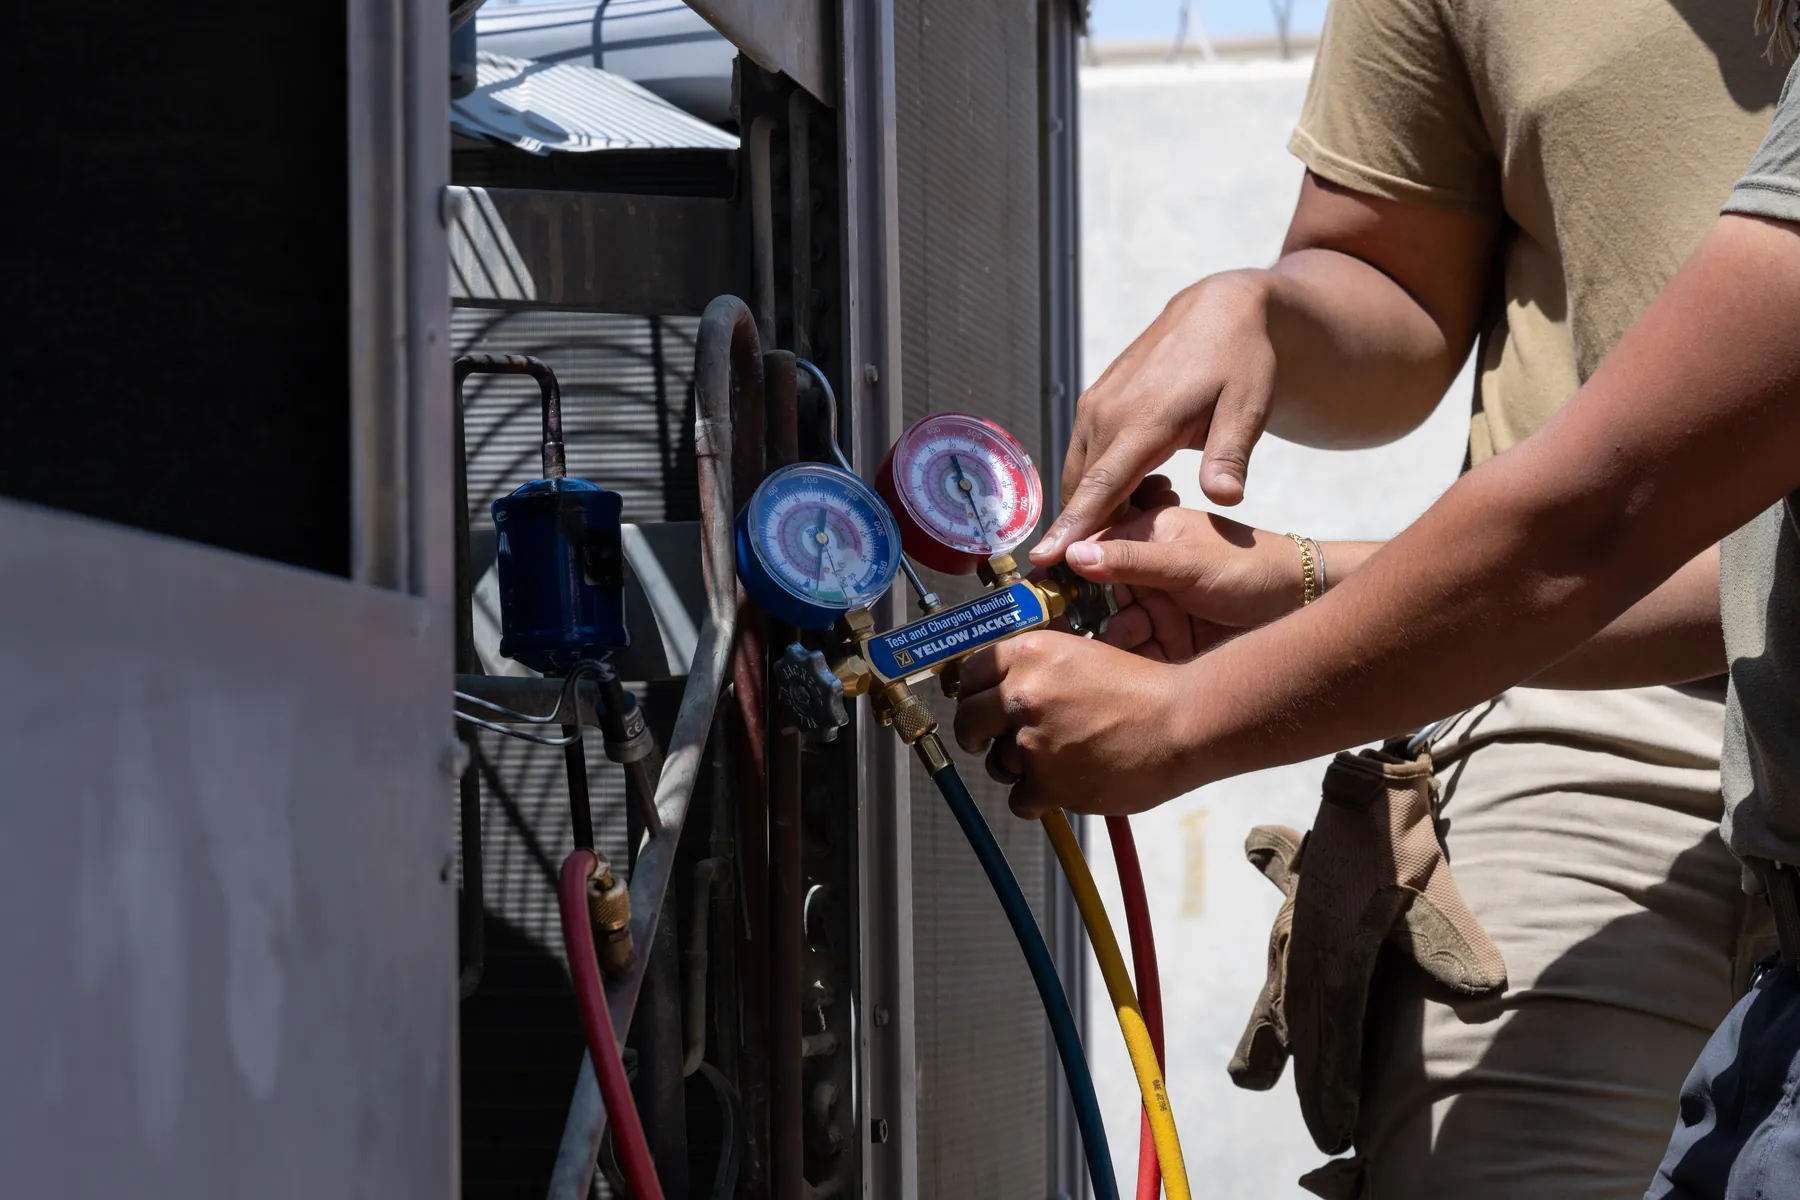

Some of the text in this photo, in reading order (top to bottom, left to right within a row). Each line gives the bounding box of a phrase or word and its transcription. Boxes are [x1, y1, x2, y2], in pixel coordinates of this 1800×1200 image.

[966, 429, 983, 440] 500
[1003, 454, 1017, 469] 600
[802, 476, 819, 484] 200
[843, 488, 859, 501] 250
[1020, 496, 1028, 511] 700
[874, 520, 886, 537] 300
[878, 560, 888, 575] 350
[886, 592, 1015, 649] Test and Charging Manifold
[912, 629, 970, 659] YELLOW
